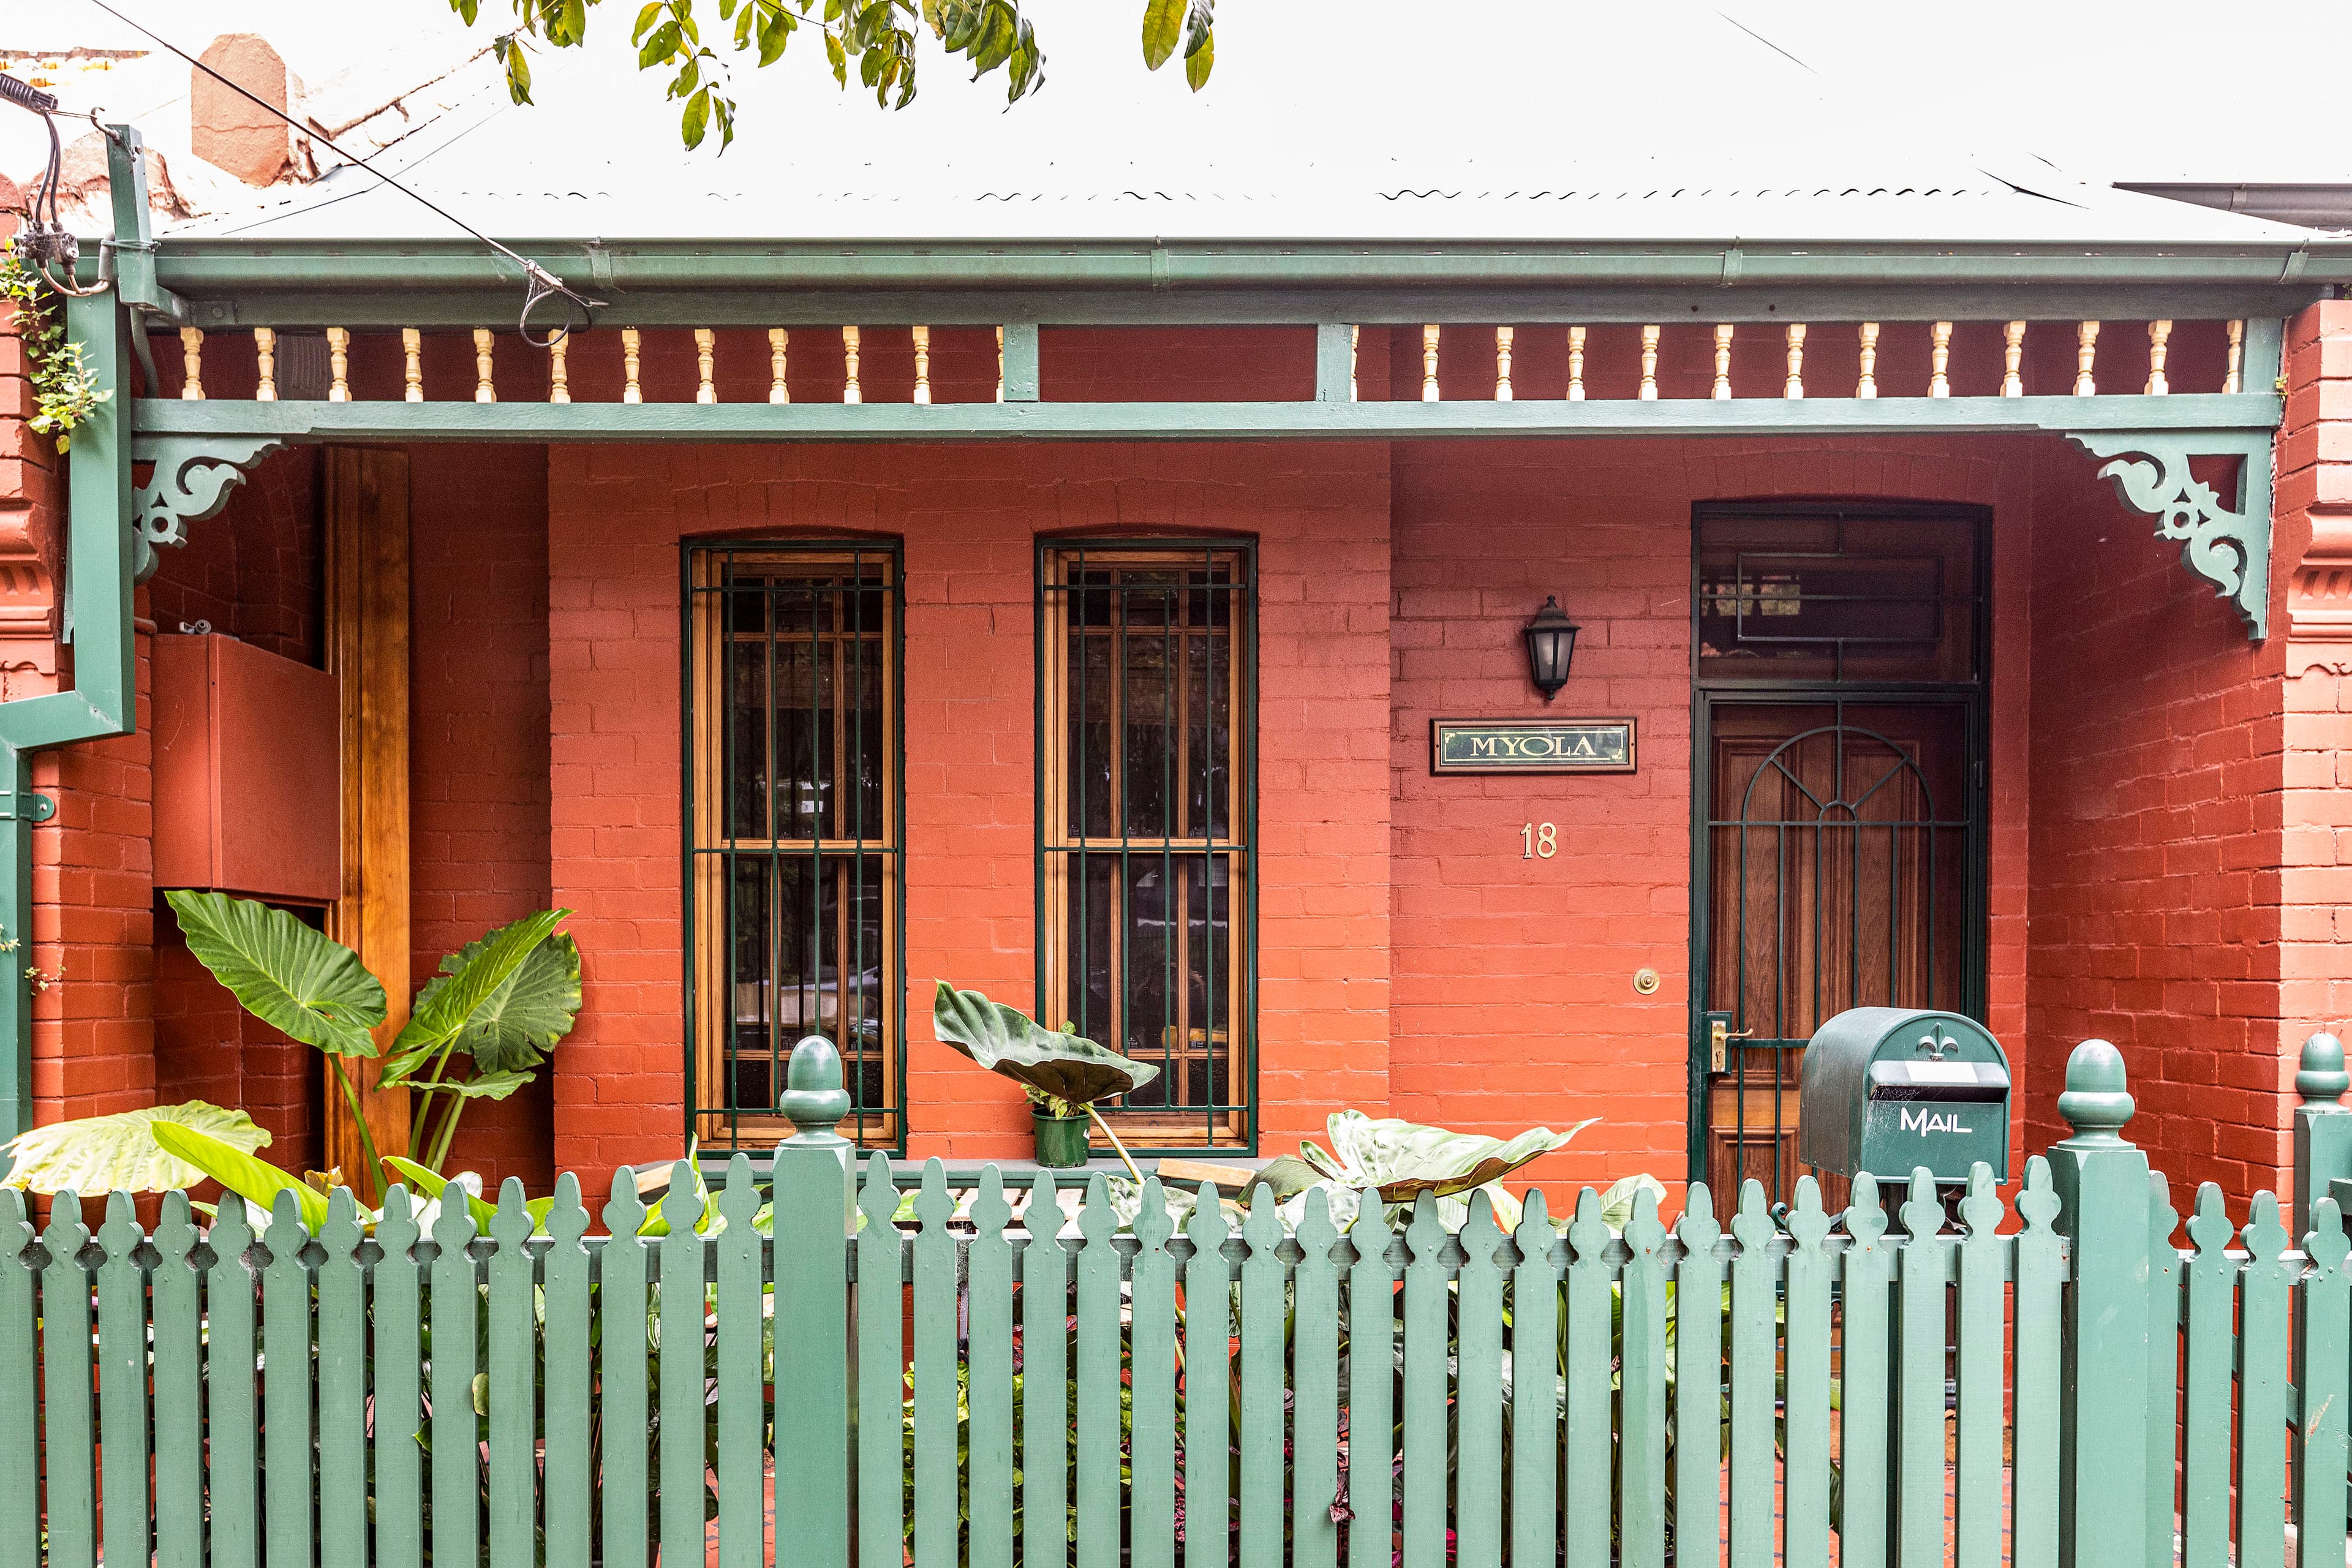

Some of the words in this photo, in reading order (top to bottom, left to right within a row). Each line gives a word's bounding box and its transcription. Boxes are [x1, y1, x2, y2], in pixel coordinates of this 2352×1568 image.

[1470, 736, 1597, 756] MYOLA
[1520, 822, 1557, 859] 18
[1900, 1107, 1972, 1137] MAIL
